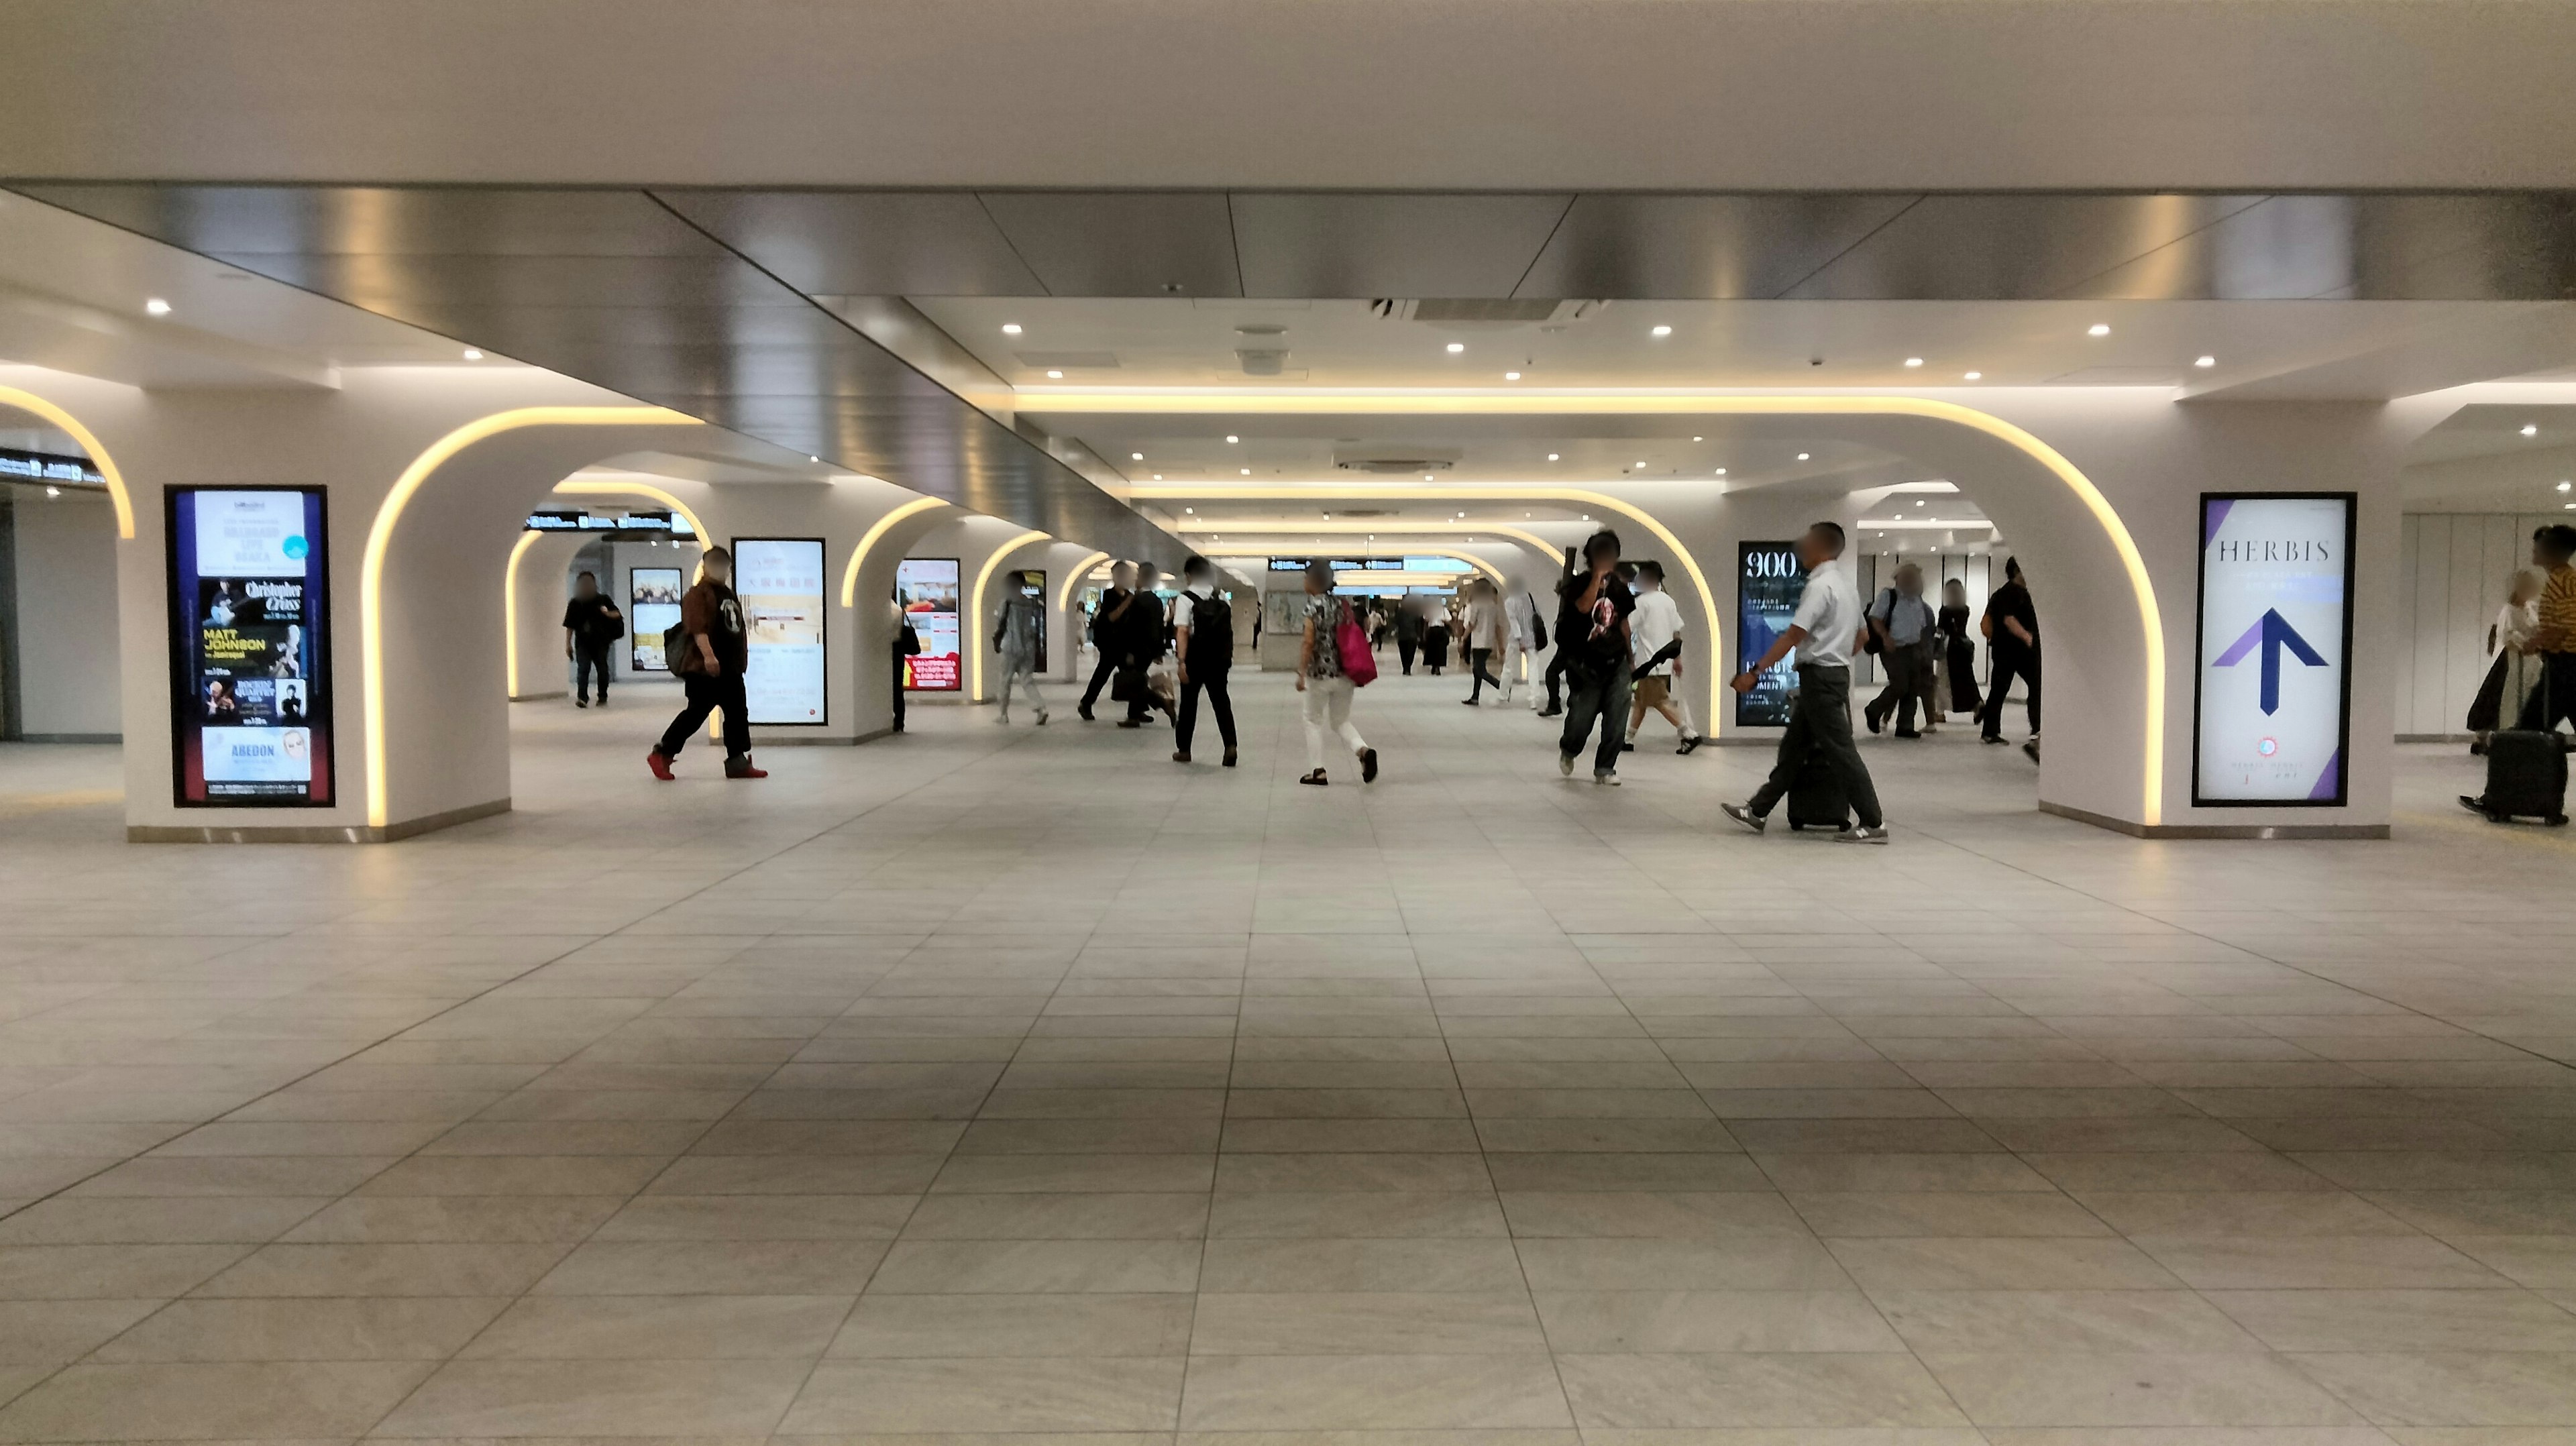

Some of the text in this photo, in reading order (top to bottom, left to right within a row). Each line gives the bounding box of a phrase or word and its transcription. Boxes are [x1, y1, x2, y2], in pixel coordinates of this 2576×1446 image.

[2220, 541, 2329, 561] HERBIS
[1746, 551, 1796, 577] 900
[203, 629, 238, 638] MATT
[204, 638, 266, 651] JOHNSON
[231, 744, 275, 757] ABEDON
